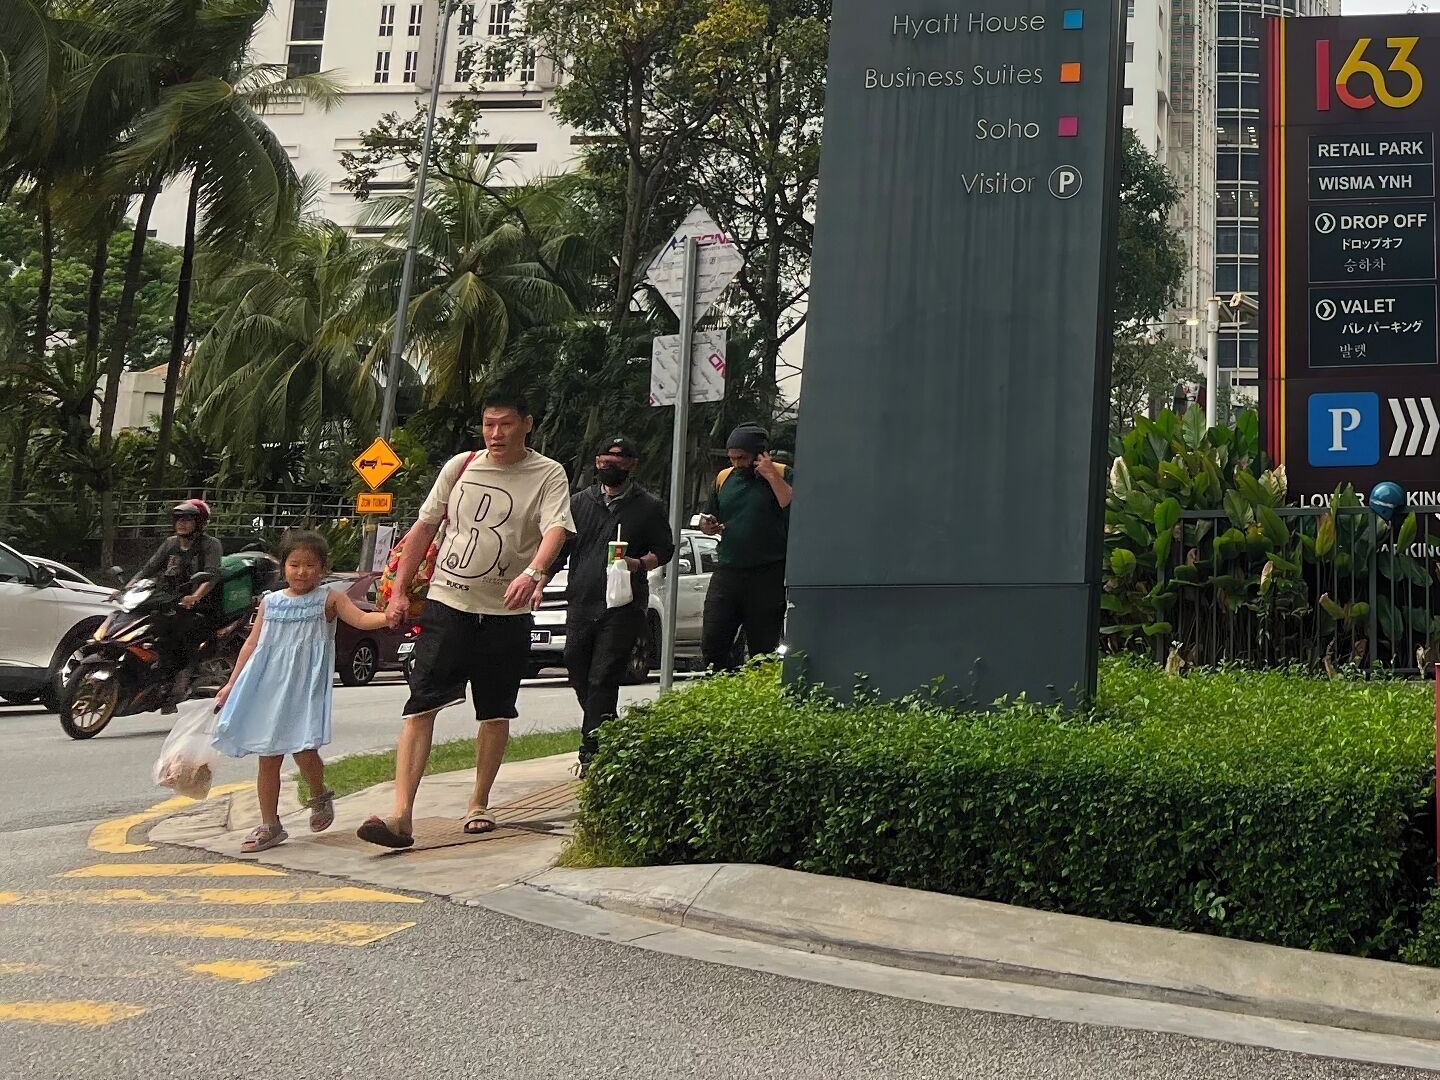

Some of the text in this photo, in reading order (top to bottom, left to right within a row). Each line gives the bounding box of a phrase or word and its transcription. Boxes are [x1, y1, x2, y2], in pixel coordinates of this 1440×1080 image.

[893, 12, 1046, 39] Hyatt House
[864, 63, 1043, 90] Business Suites
[1316, 37, 1423, 111] 163
[976, 117, 1040, 140] Soho
[1318, 141, 1424, 158] RETAIL PARK
[961, 172, 1075, 195] Visitor P
[1318, 174, 1412, 191] WISMA YNH
[1340, 213, 1427, 230] DROP OFF
[1342, 237, 1403, 250] ドロップオフ
[1343, 257, 1386, 273] 승하차
[1340, 298, 1396, 315] VALET
[1327, 408, 1361, 451] P
[1300, 492, 1366, 509] LOWR
